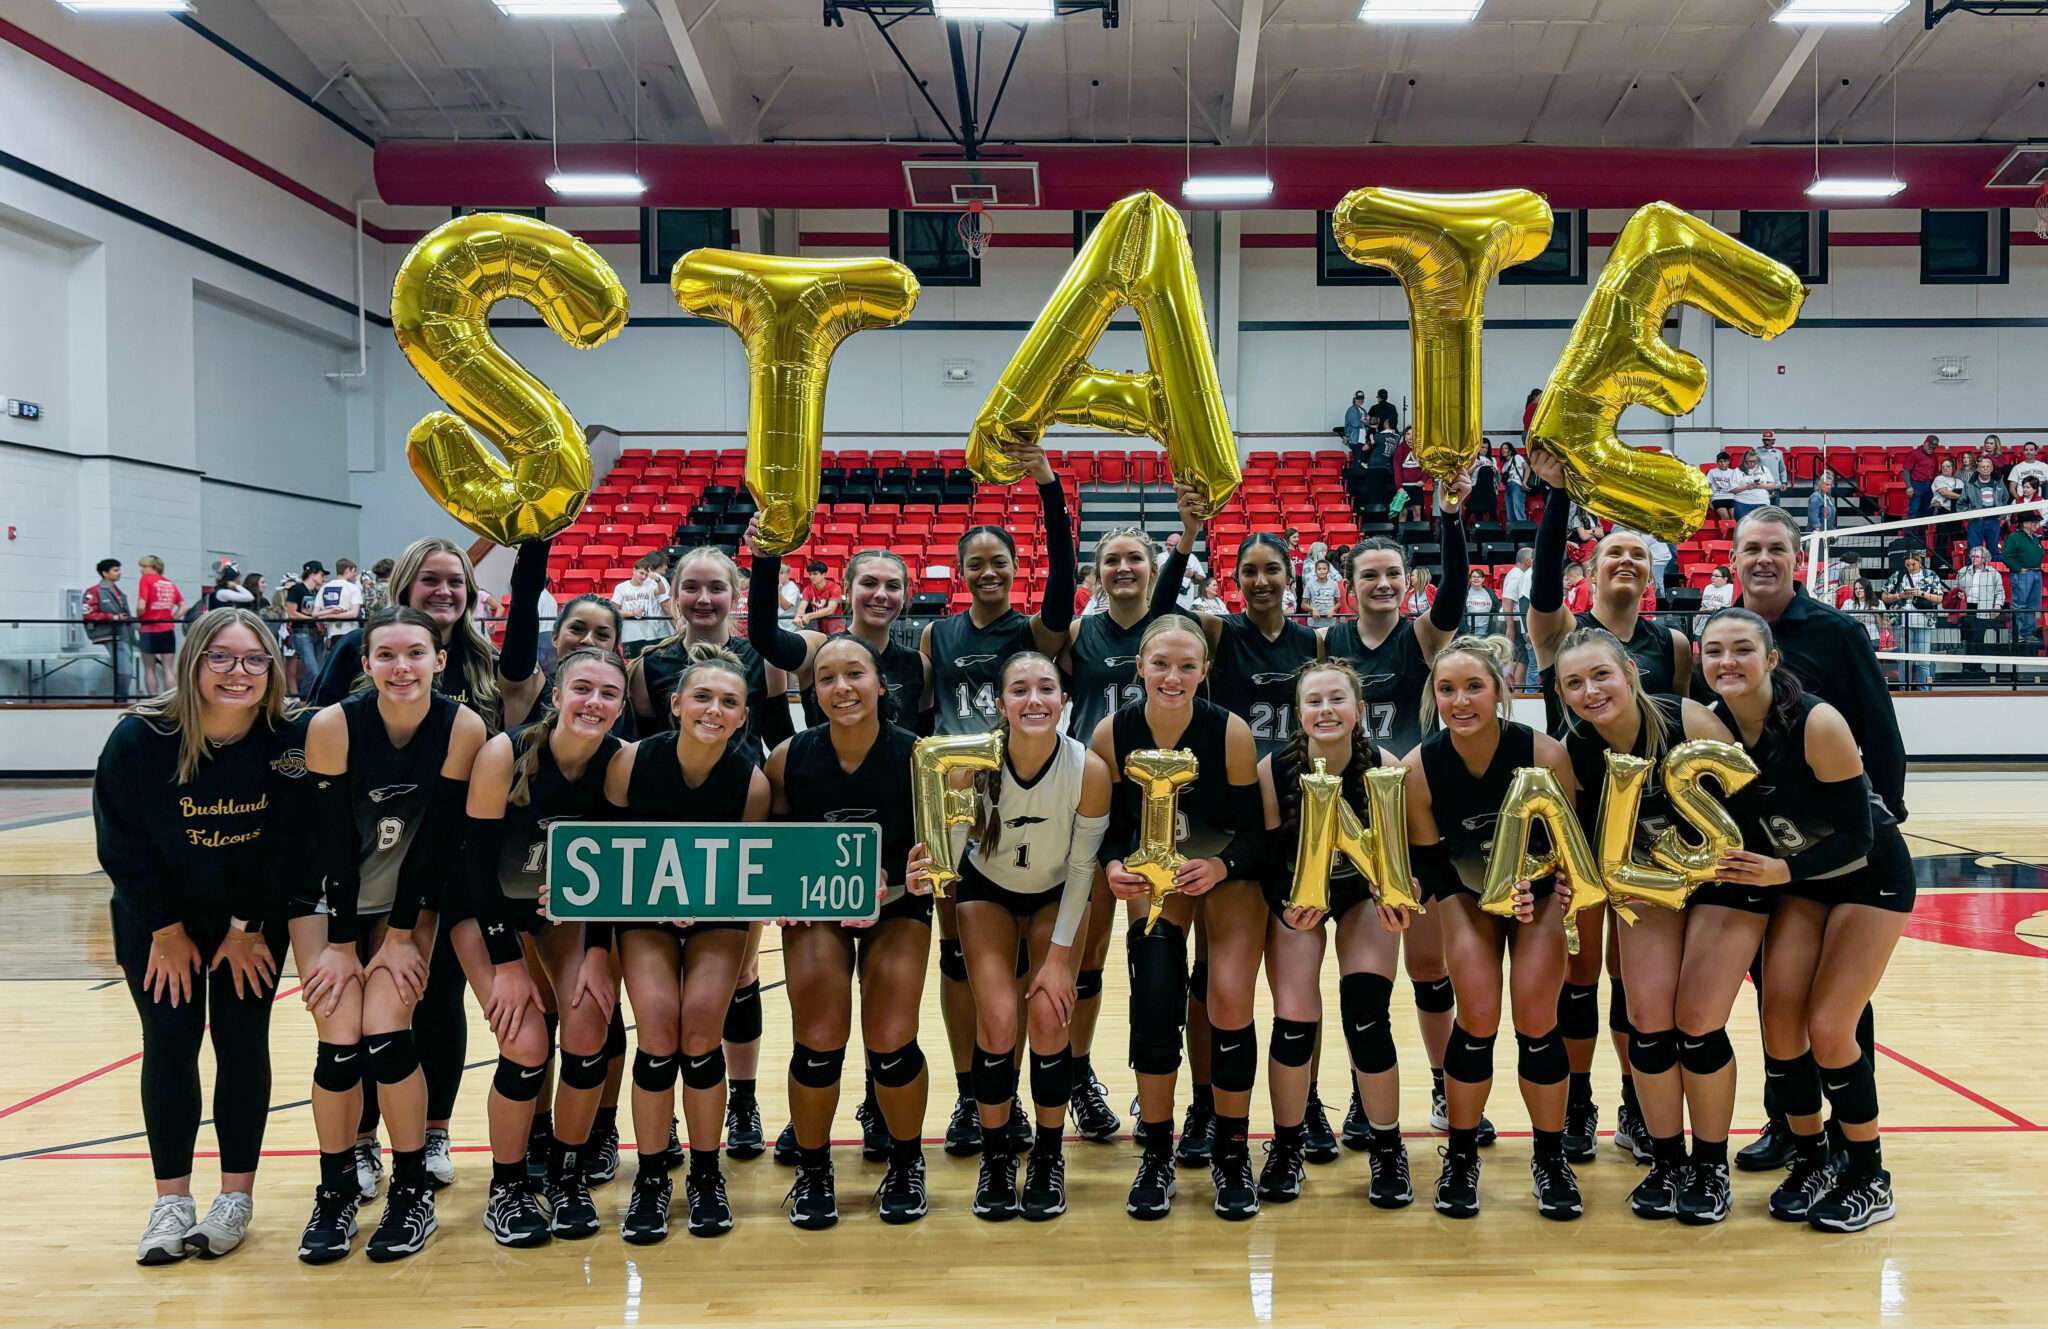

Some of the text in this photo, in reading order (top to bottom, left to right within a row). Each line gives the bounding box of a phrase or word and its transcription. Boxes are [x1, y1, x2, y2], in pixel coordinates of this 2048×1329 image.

[391, 187, 1807, 555] STATE
[956, 682, 999, 719] 14
[1104, 683, 1146, 717] 12
[1250, 702, 1291, 741] 21
[1361, 702, 1397, 740] 17
[179, 793, 268, 817] Bushland
[186, 828, 260, 847] Falcons
[377, 816, 404, 851] 8
[912, 732, 1762, 918] FINALS
[522, 842, 546, 873] 1
[835, 833, 866, 867] ST
[1014, 843, 1031, 870] 1
[562, 837, 773, 906] STATE
[800, 875, 865, 909] 1400
